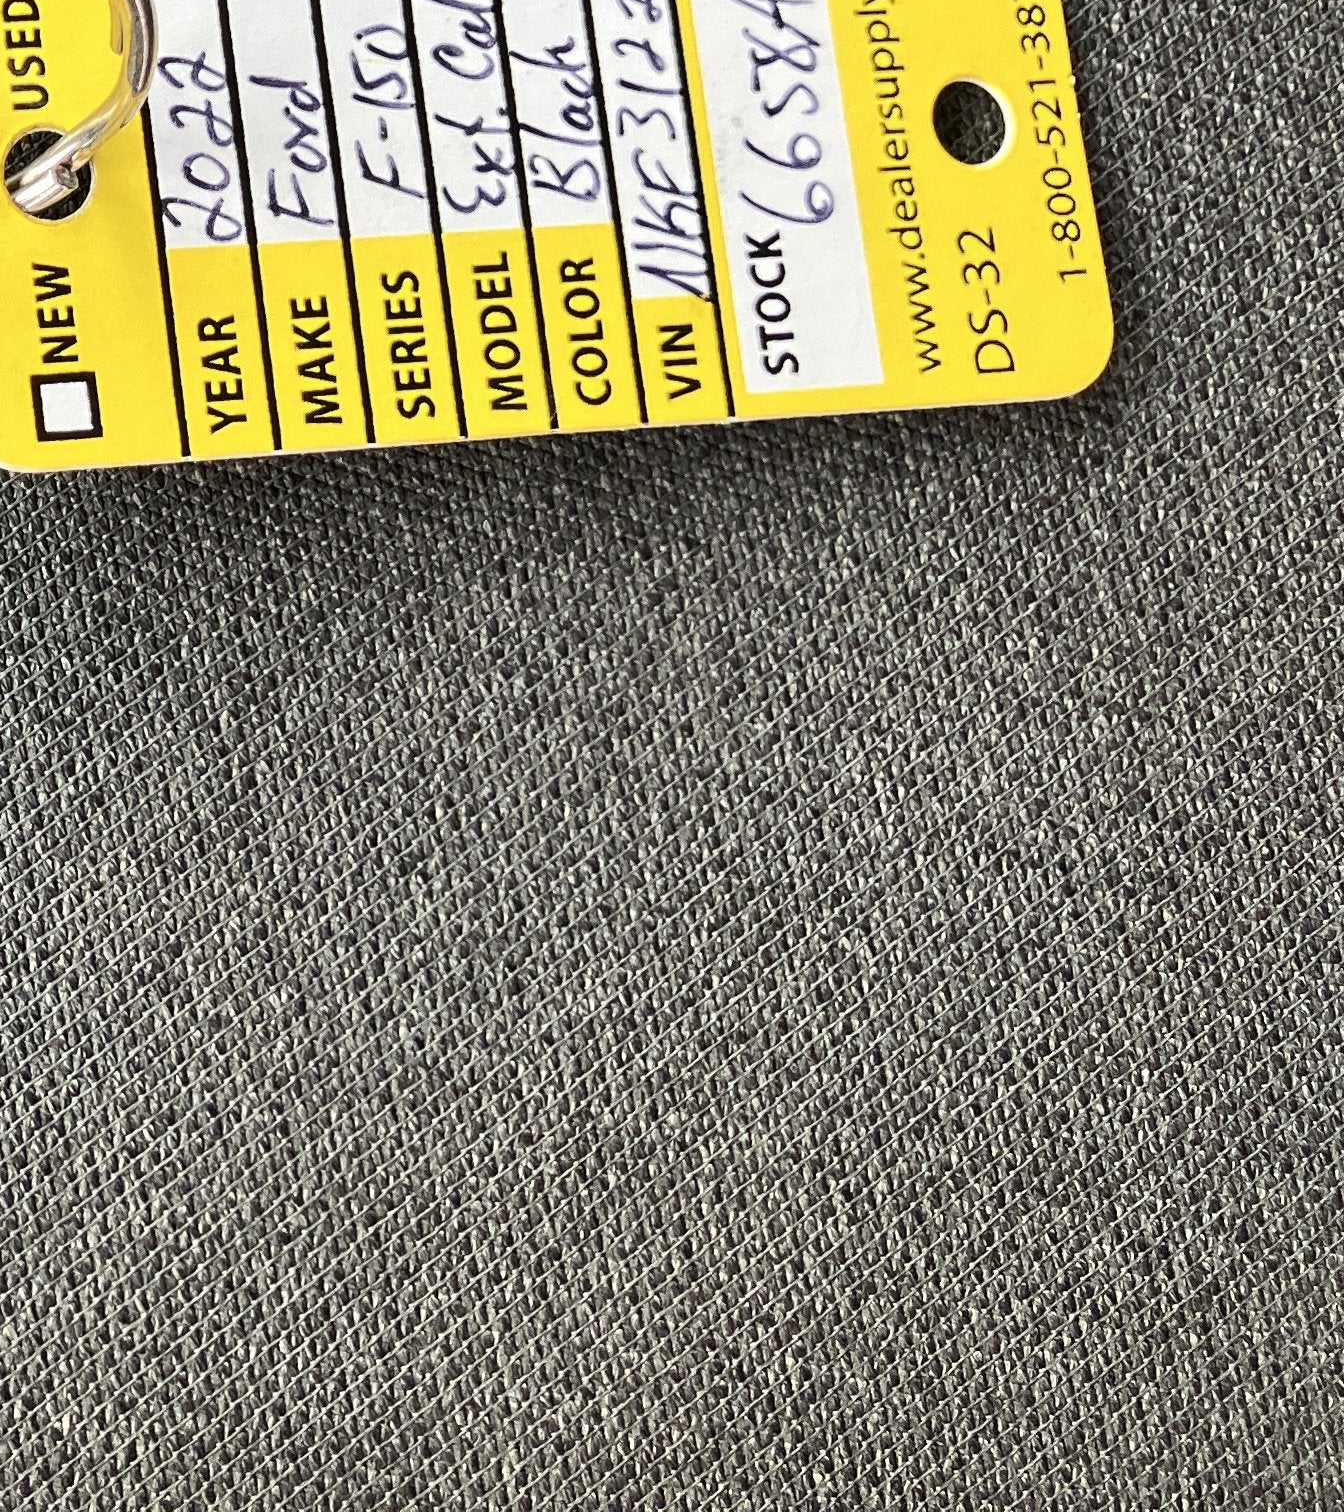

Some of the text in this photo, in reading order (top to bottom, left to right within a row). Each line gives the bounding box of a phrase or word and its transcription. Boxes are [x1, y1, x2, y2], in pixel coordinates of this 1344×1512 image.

[157, 50, 243, 242] 2022
[249, 76, 335, 227] Ford
[354, 24, 426, 200] F-150
[32, 264, 80, 363] NEW
[198, 314, 242, 434] YEAR
[290, 294, 343, 425] MAKE
[381, 271, 435, 419] SERIES
[472, 251, 528, 412] MODEL
[560, 256, 612, 407] COLOR
[659, 323, 702, 400] VIN
[745, 232, 800, 376] STOCK
[956, 227, 1015, 374] DS-32
